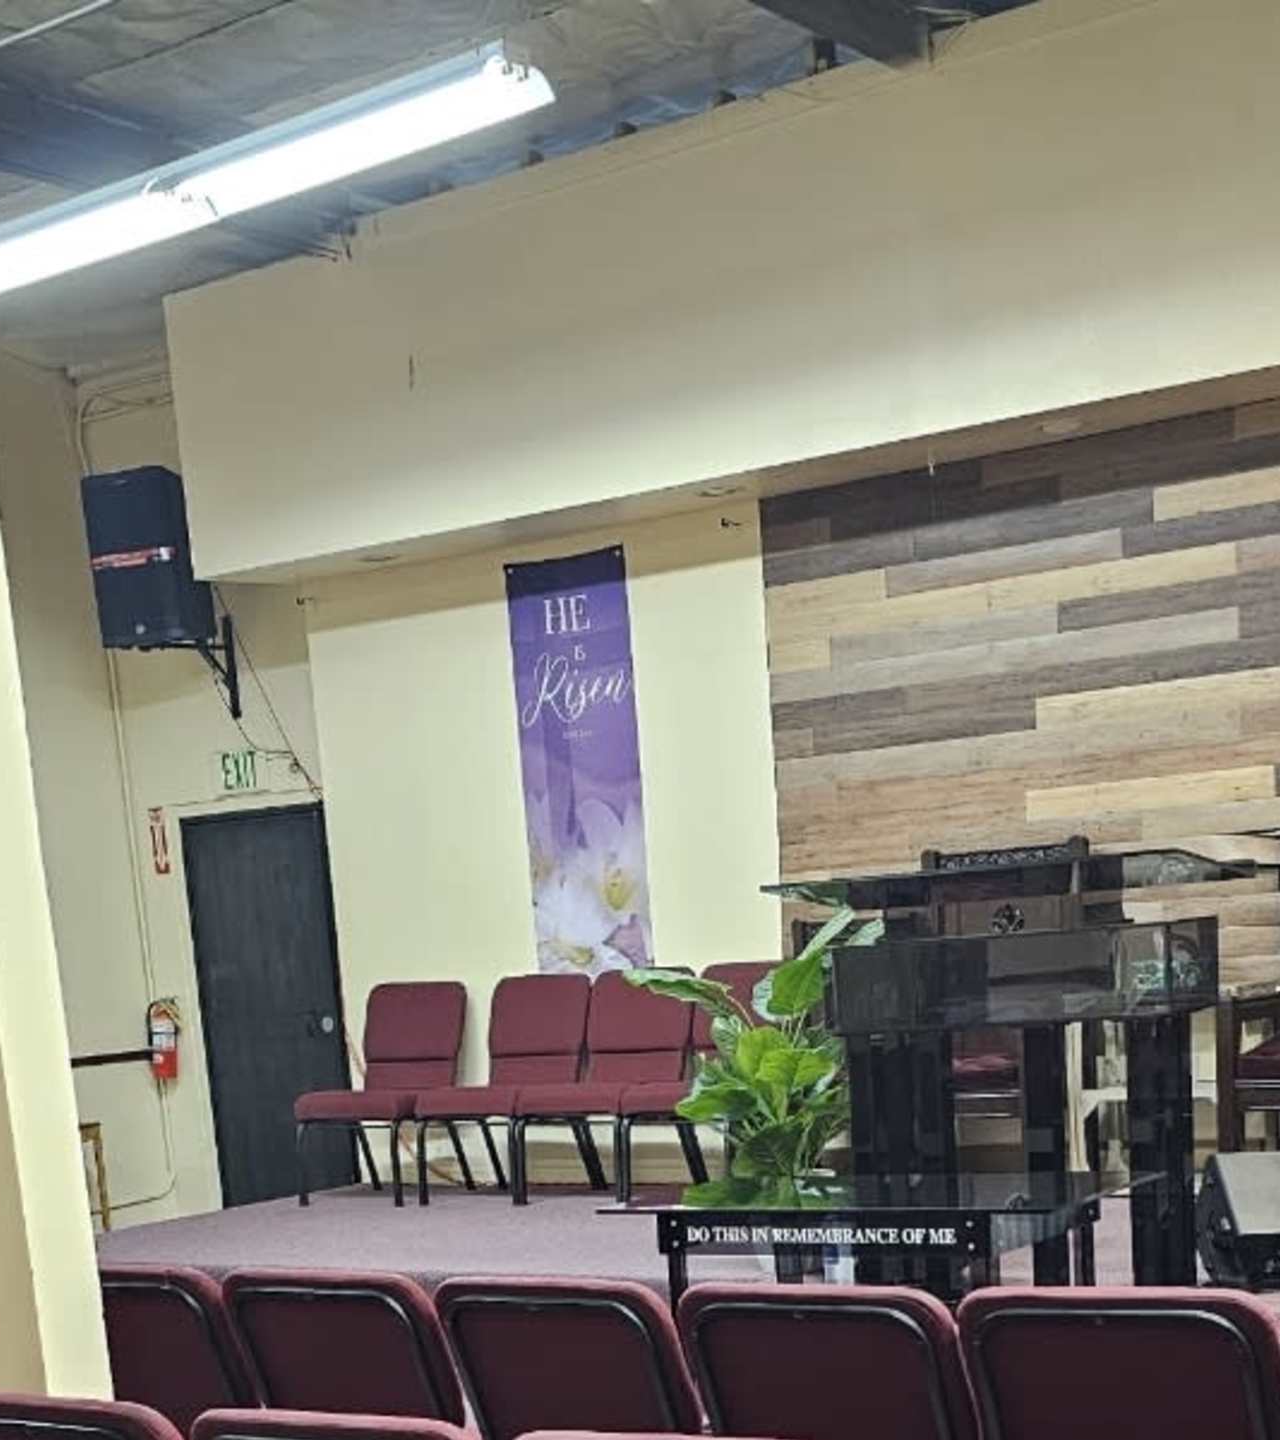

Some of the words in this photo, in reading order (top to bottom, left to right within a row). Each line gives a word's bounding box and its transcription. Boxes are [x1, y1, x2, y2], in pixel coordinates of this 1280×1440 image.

[544, 594, 591, 635] HE
[522, 652, 631, 728] Risen
[221, 750, 257, 790] EXIT
[687, 1225, 711, 1242] DO
[711, 1225, 750, 1242] THIS
[751, 1226, 771, 1242] IN
[772, 1227, 900, 1245] REMEMBRANCE
[901, 1228, 926, 1245] OF
[928, 1228, 957, 1245] ME
